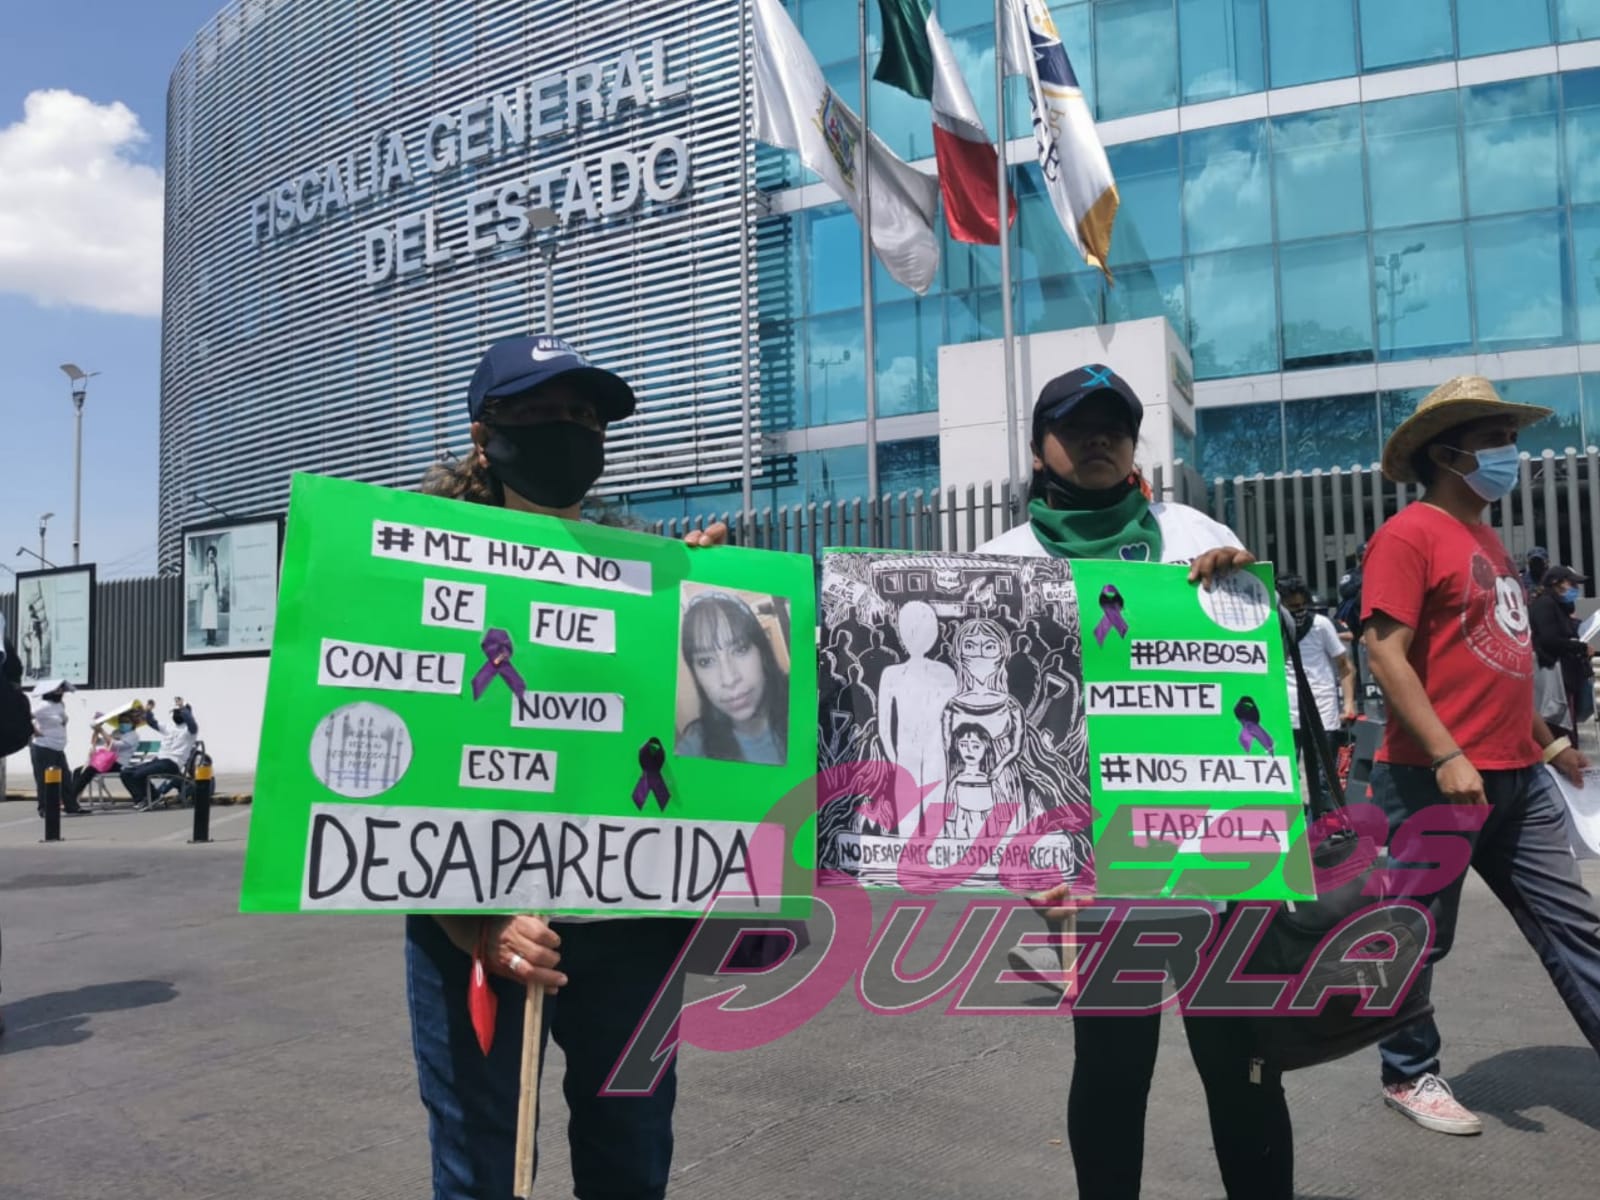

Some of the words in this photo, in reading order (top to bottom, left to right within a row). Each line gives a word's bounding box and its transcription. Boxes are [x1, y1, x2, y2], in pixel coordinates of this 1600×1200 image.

[250, 127, 414, 246] FISCALÍA
[424, 38, 690, 173] GENERAL
[364, 209, 452, 285] DEL
[466, 134, 689, 253] ESTADO
[488, 541, 566, 575] HIJA
[576, 556, 622, 582] NO
[430, 586, 475, 623] SE
[535, 608, 599, 643] FUE
[1131, 641, 1267, 665] #BARBOSA
[1471, 623, 1522, 670] MICKEY
[325, 645, 404, 681] CON
[416, 654, 456, 685] EL
[518, 694, 607, 722] NOVIO
[1090, 684, 1215, 709] MIENTE
[468, 749, 550, 782] ESTA
[1200, 759, 1287, 785] FALTA
[1144, 812, 1281, 843] FABIOLA
[308, 813, 760, 907] DESAPARECIDA
[841, 842, 861, 863] NO
